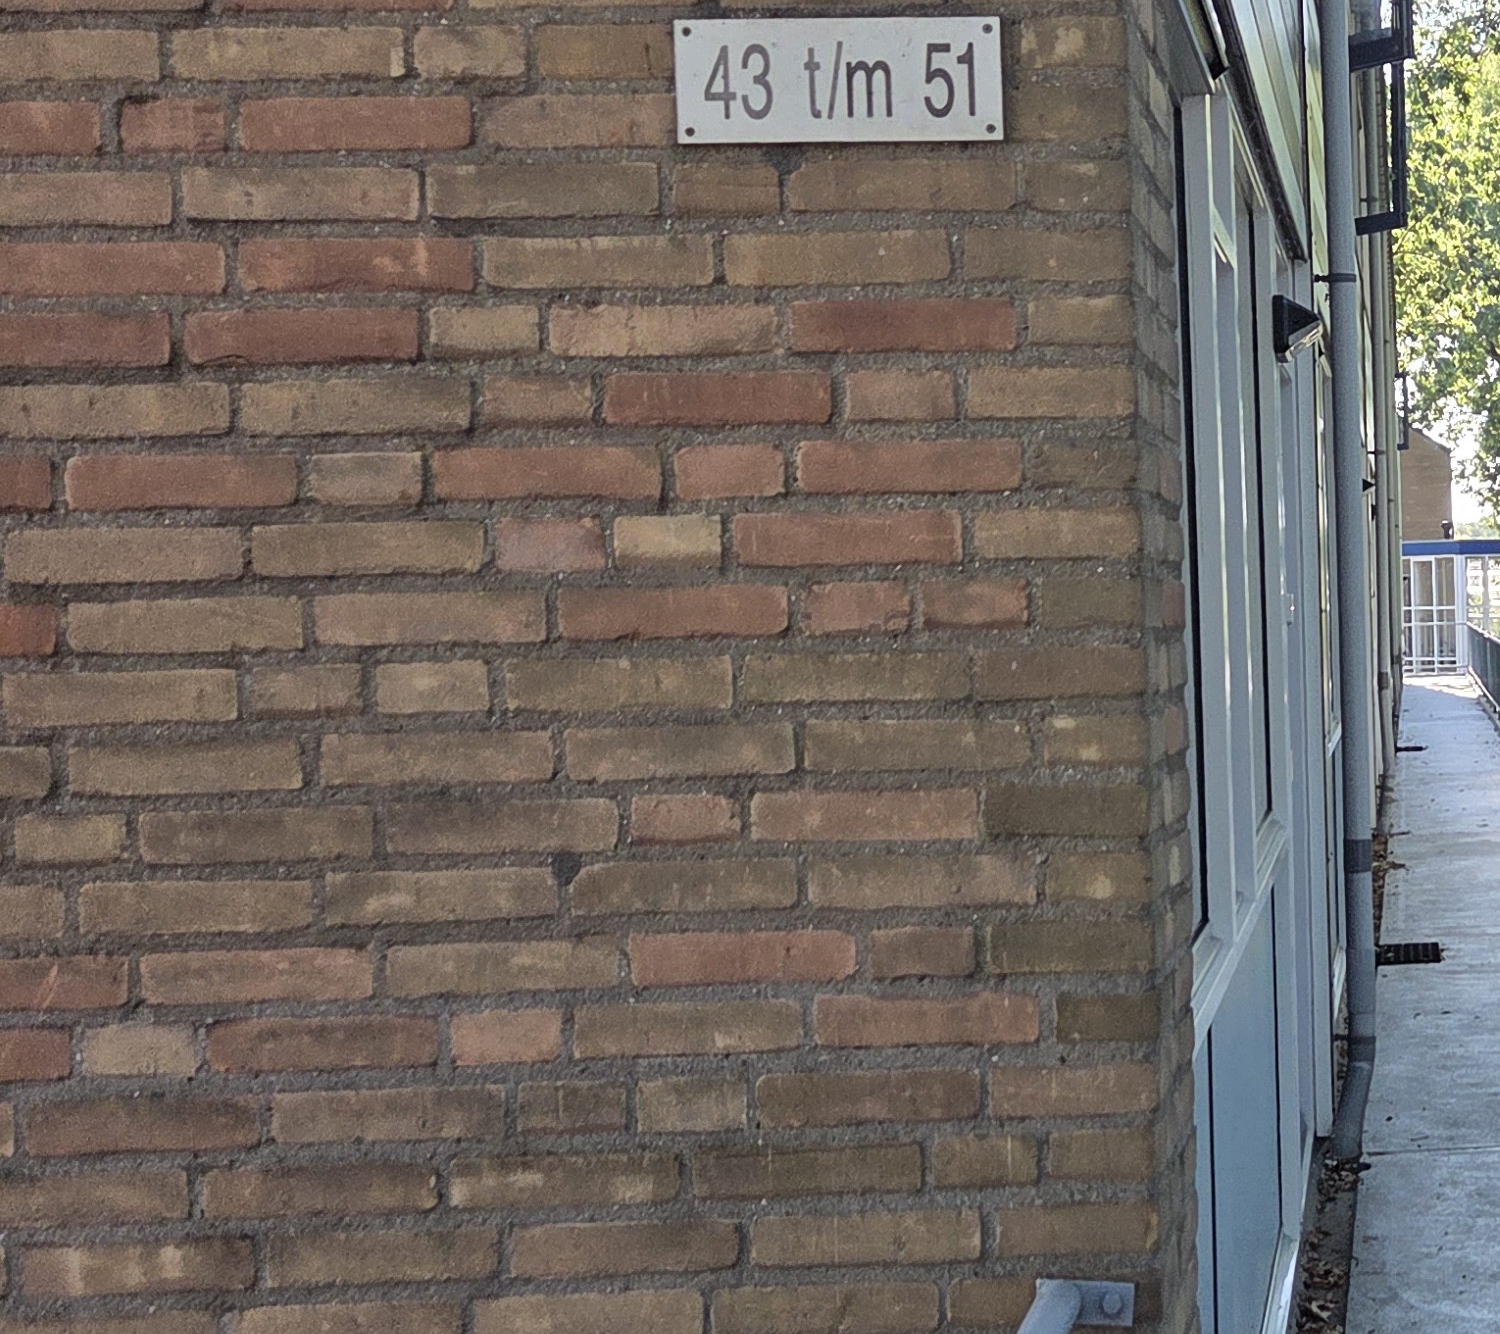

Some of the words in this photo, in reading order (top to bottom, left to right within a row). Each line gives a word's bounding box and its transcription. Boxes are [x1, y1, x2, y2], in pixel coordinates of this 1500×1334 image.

[704, 44, 774, 120] 43
[803, 41, 893, 120] t/m
[923, 42, 976, 118] 51
